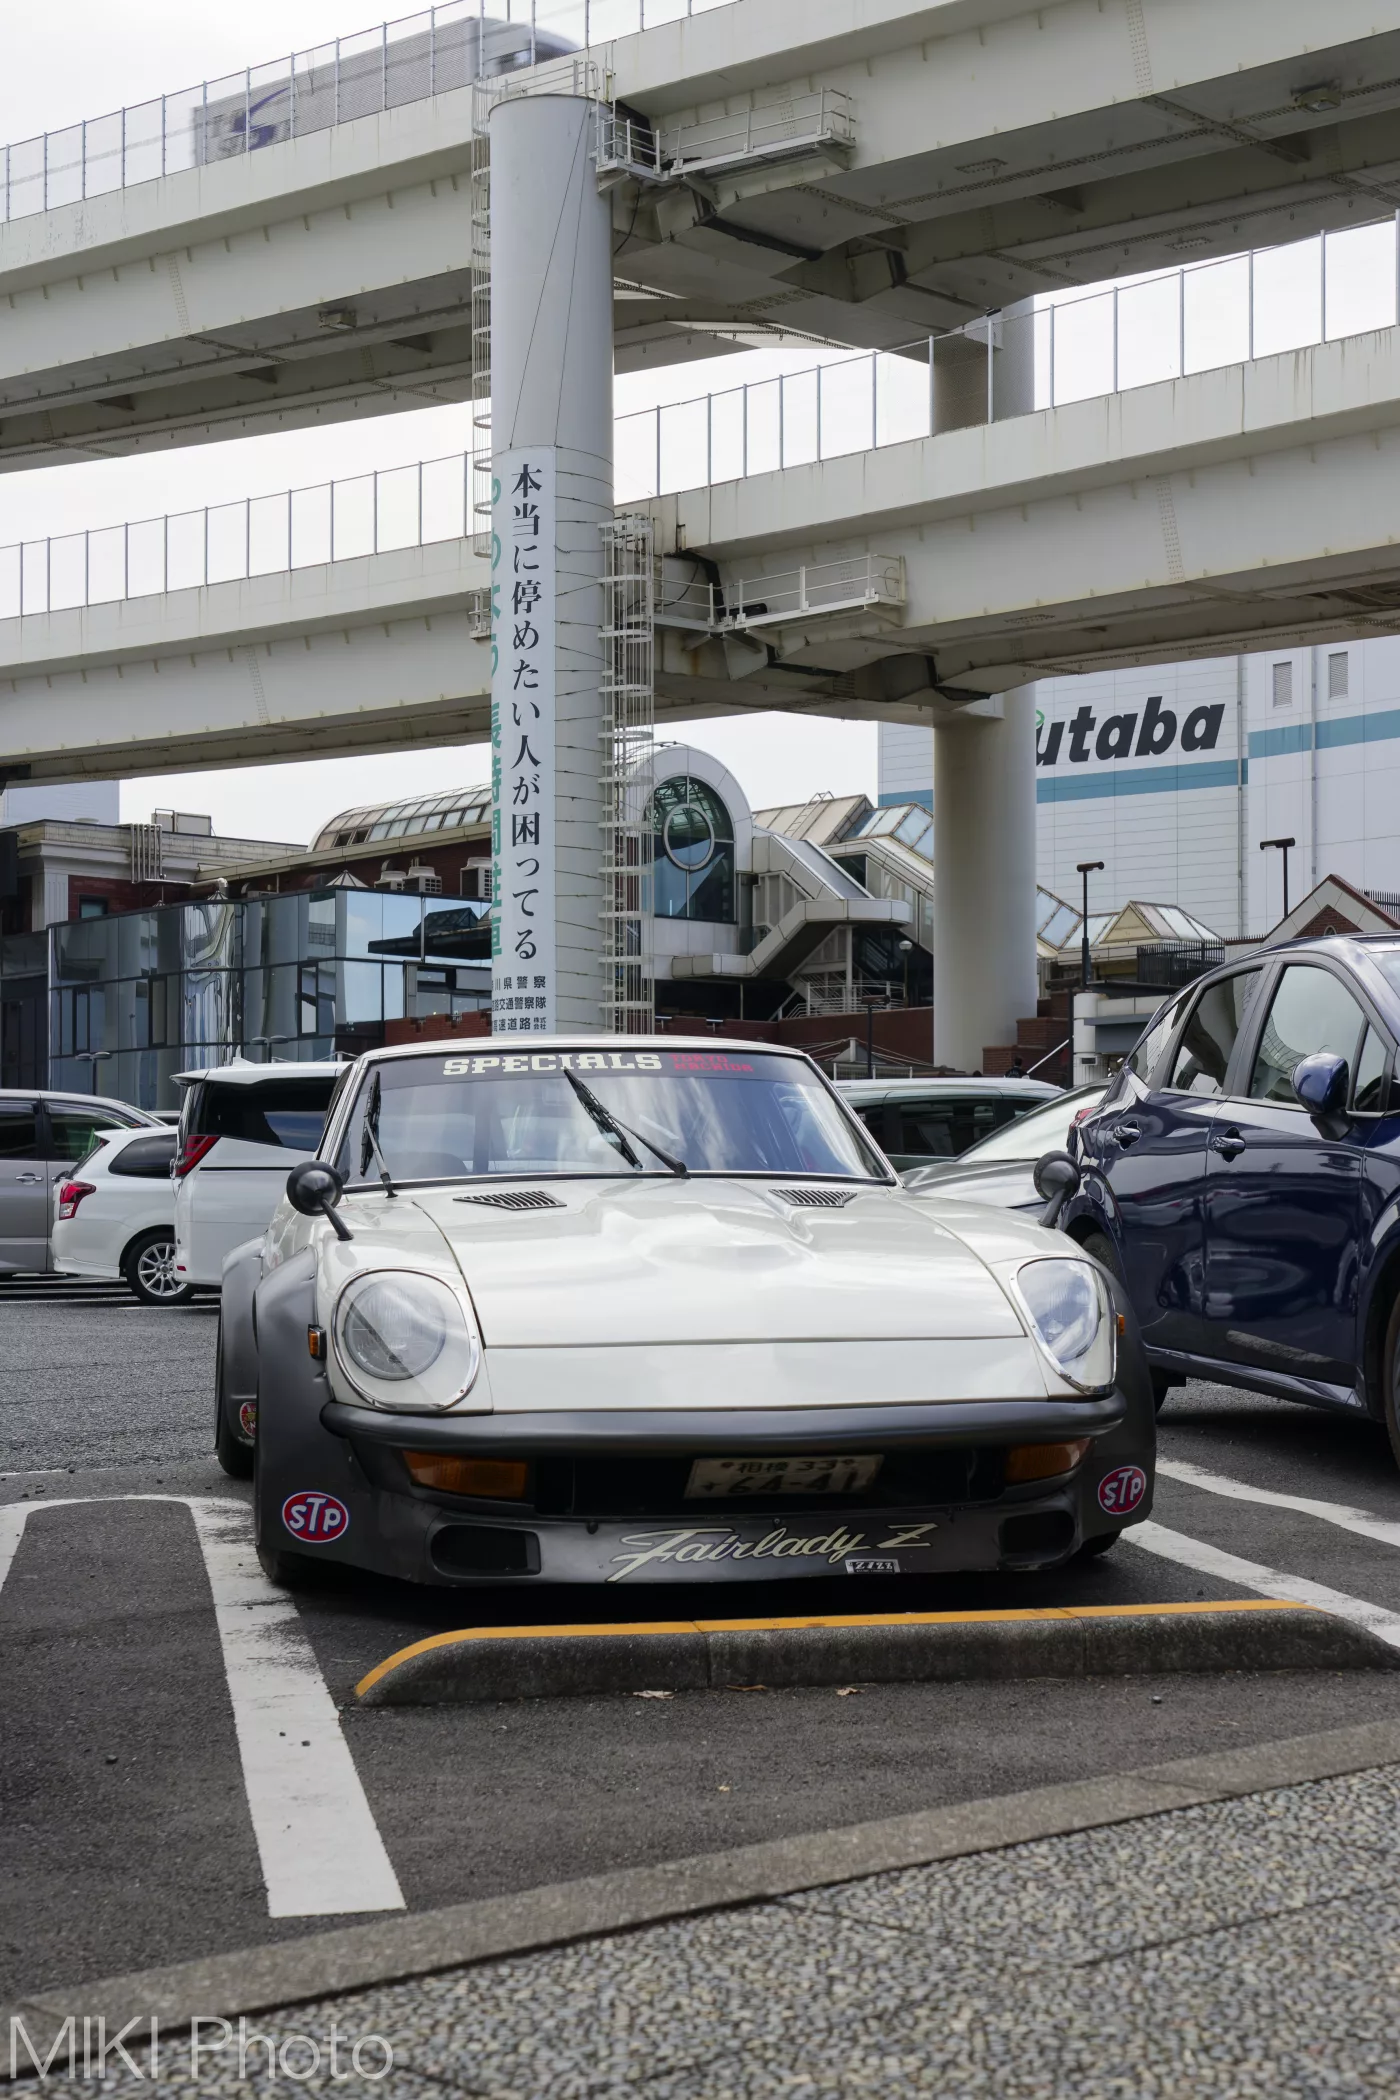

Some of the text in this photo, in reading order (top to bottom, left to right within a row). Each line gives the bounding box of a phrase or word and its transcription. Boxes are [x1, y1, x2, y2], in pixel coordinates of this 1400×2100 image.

[510, 463, 543, 960] 本当に停めたい人が困ってる
[492, 975, 546, 991] 川県警察
[442, 1053, 663, 1076] SPECIALS
[1103, 1470, 1142, 1507] STP
[288, 1497, 341, 1532] STP
[604, 1522, 939, 1583] Fairlady Z
